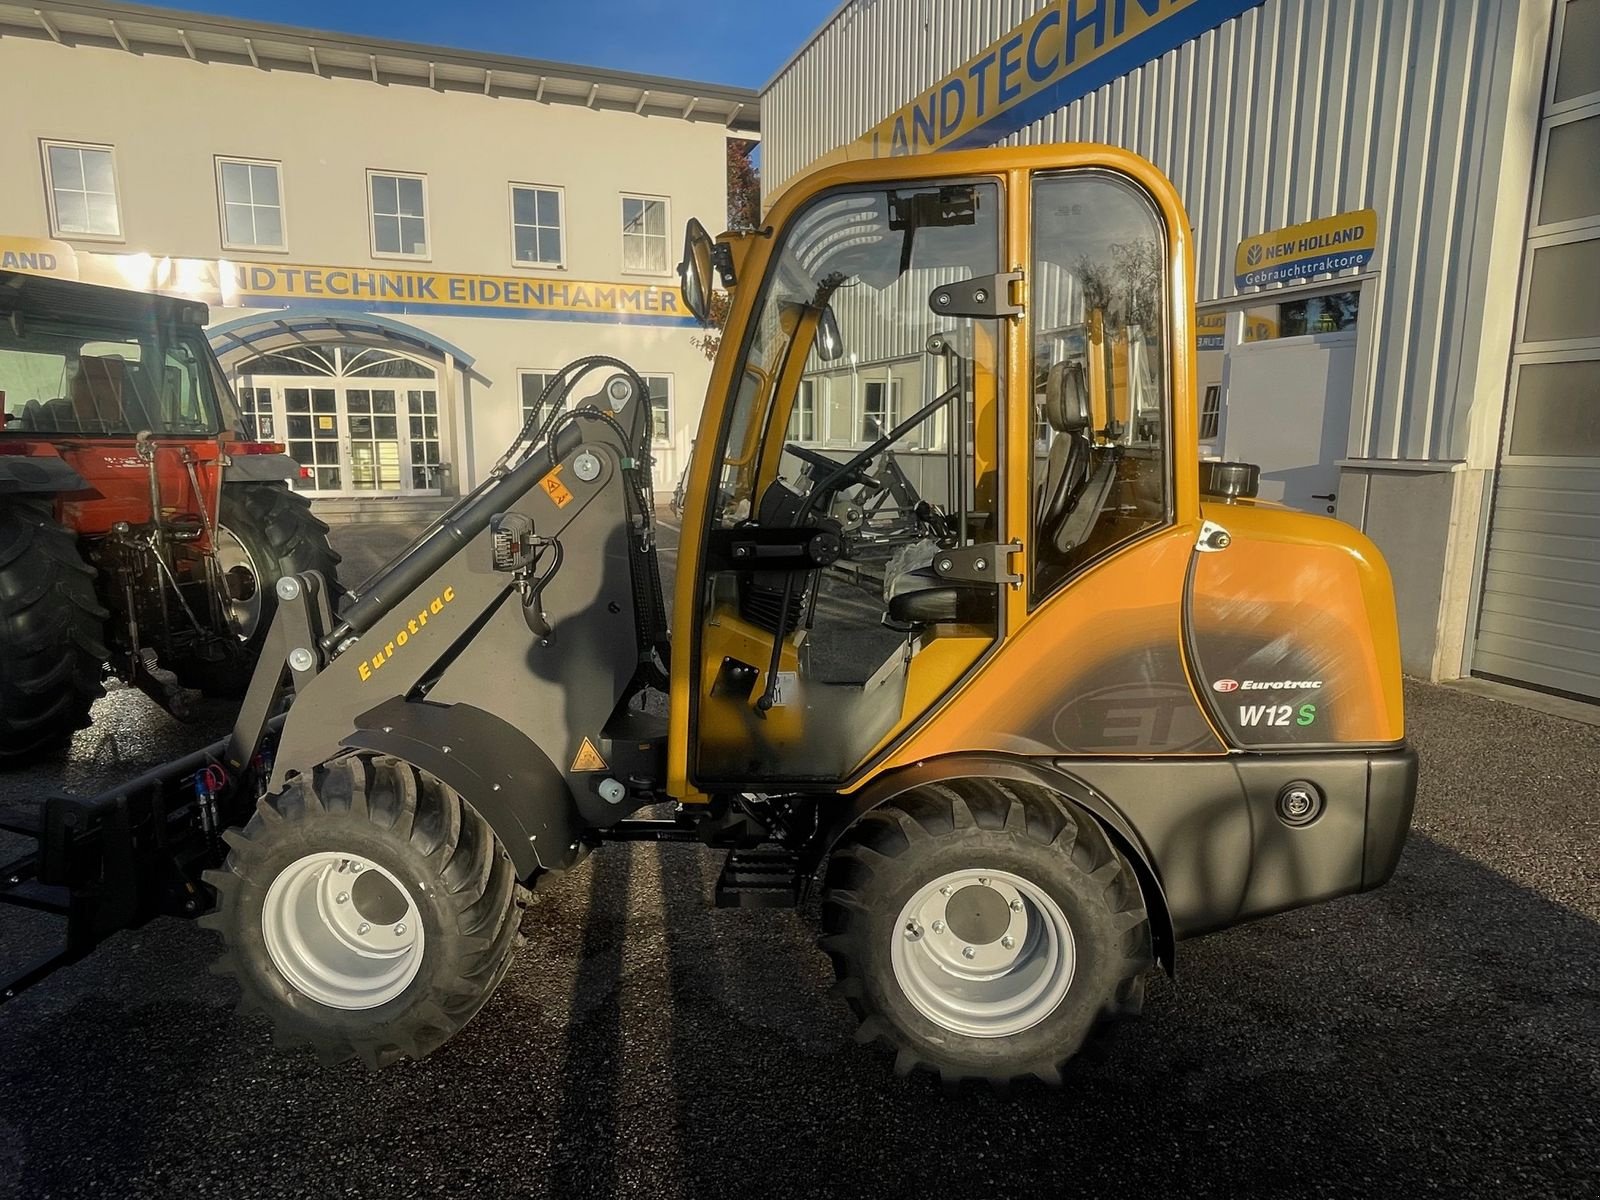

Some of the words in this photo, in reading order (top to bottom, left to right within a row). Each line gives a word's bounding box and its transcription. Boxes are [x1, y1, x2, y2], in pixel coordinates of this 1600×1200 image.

[1266, 241, 1295, 259] NEW
[1298, 226, 1364, 253] HOLLAND
[1245, 254, 1363, 285] Gebrauchttraktore
[450, 277, 677, 312] EIDENHAMMER
[358, 585, 455, 681] Eurotrac
[1240, 680, 1322, 690] Eurotrac
[1240, 705, 1293, 727] W12
[1297, 704, 1316, 726] S
